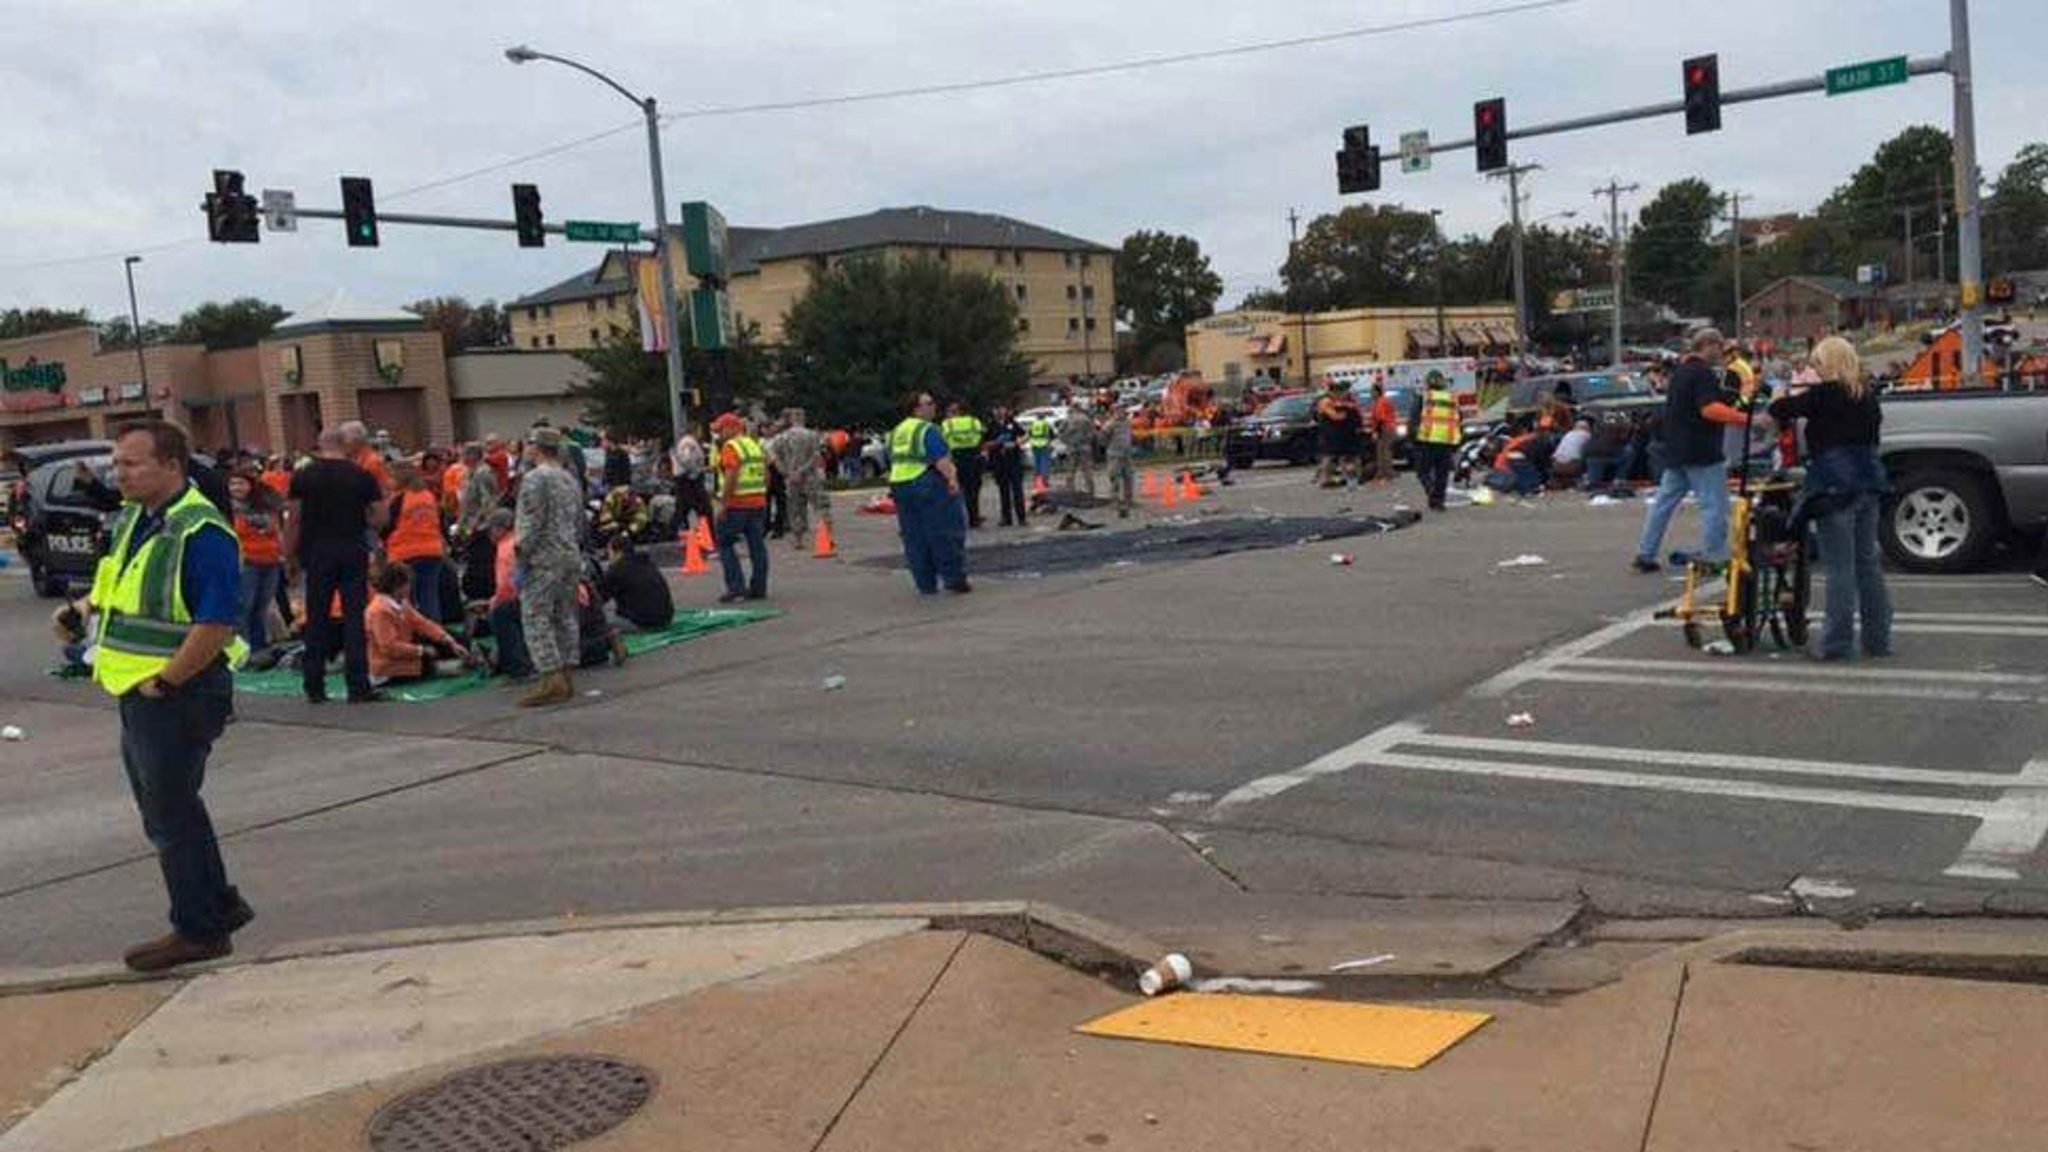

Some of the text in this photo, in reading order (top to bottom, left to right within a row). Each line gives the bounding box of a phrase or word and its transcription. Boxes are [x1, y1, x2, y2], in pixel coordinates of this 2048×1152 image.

[1835, 62, 1897, 89] MAIN ST
[47, 534, 95, 554] POLICE
